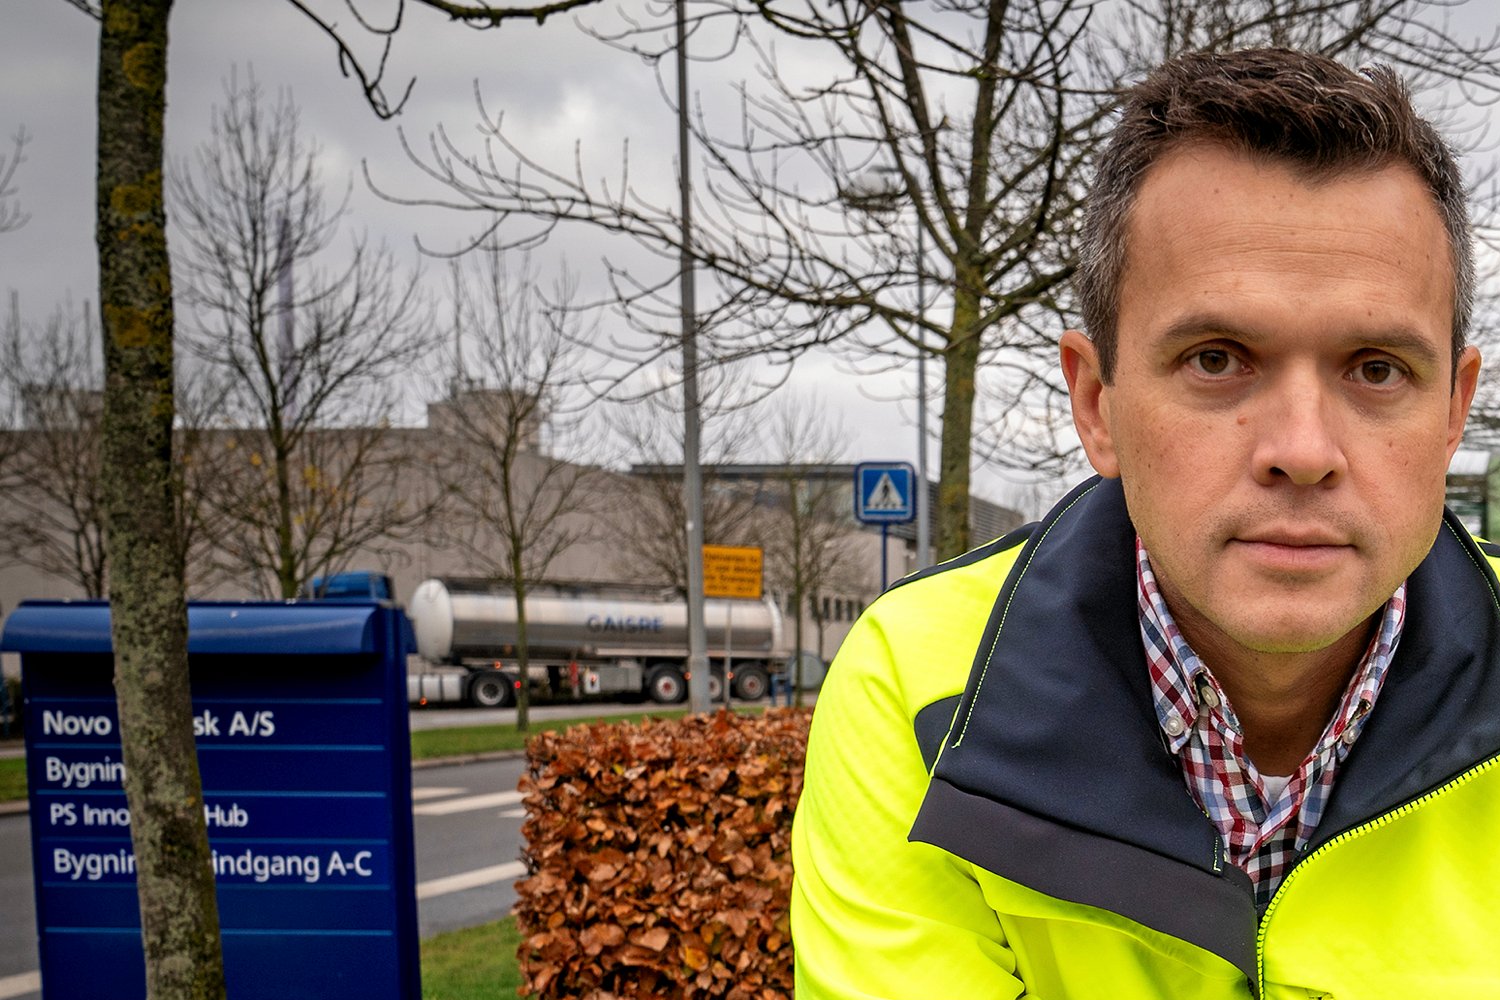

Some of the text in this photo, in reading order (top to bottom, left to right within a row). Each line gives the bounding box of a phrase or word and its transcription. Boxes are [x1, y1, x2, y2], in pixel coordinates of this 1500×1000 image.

[42, 710, 113, 736] Novo
[228, 710, 276, 737] A/S
[45, 755, 127, 788] Bygnin
[50, 802, 78, 826] PS
[203, 803, 249, 828] Hub
[326, 850, 373, 877] A-C
